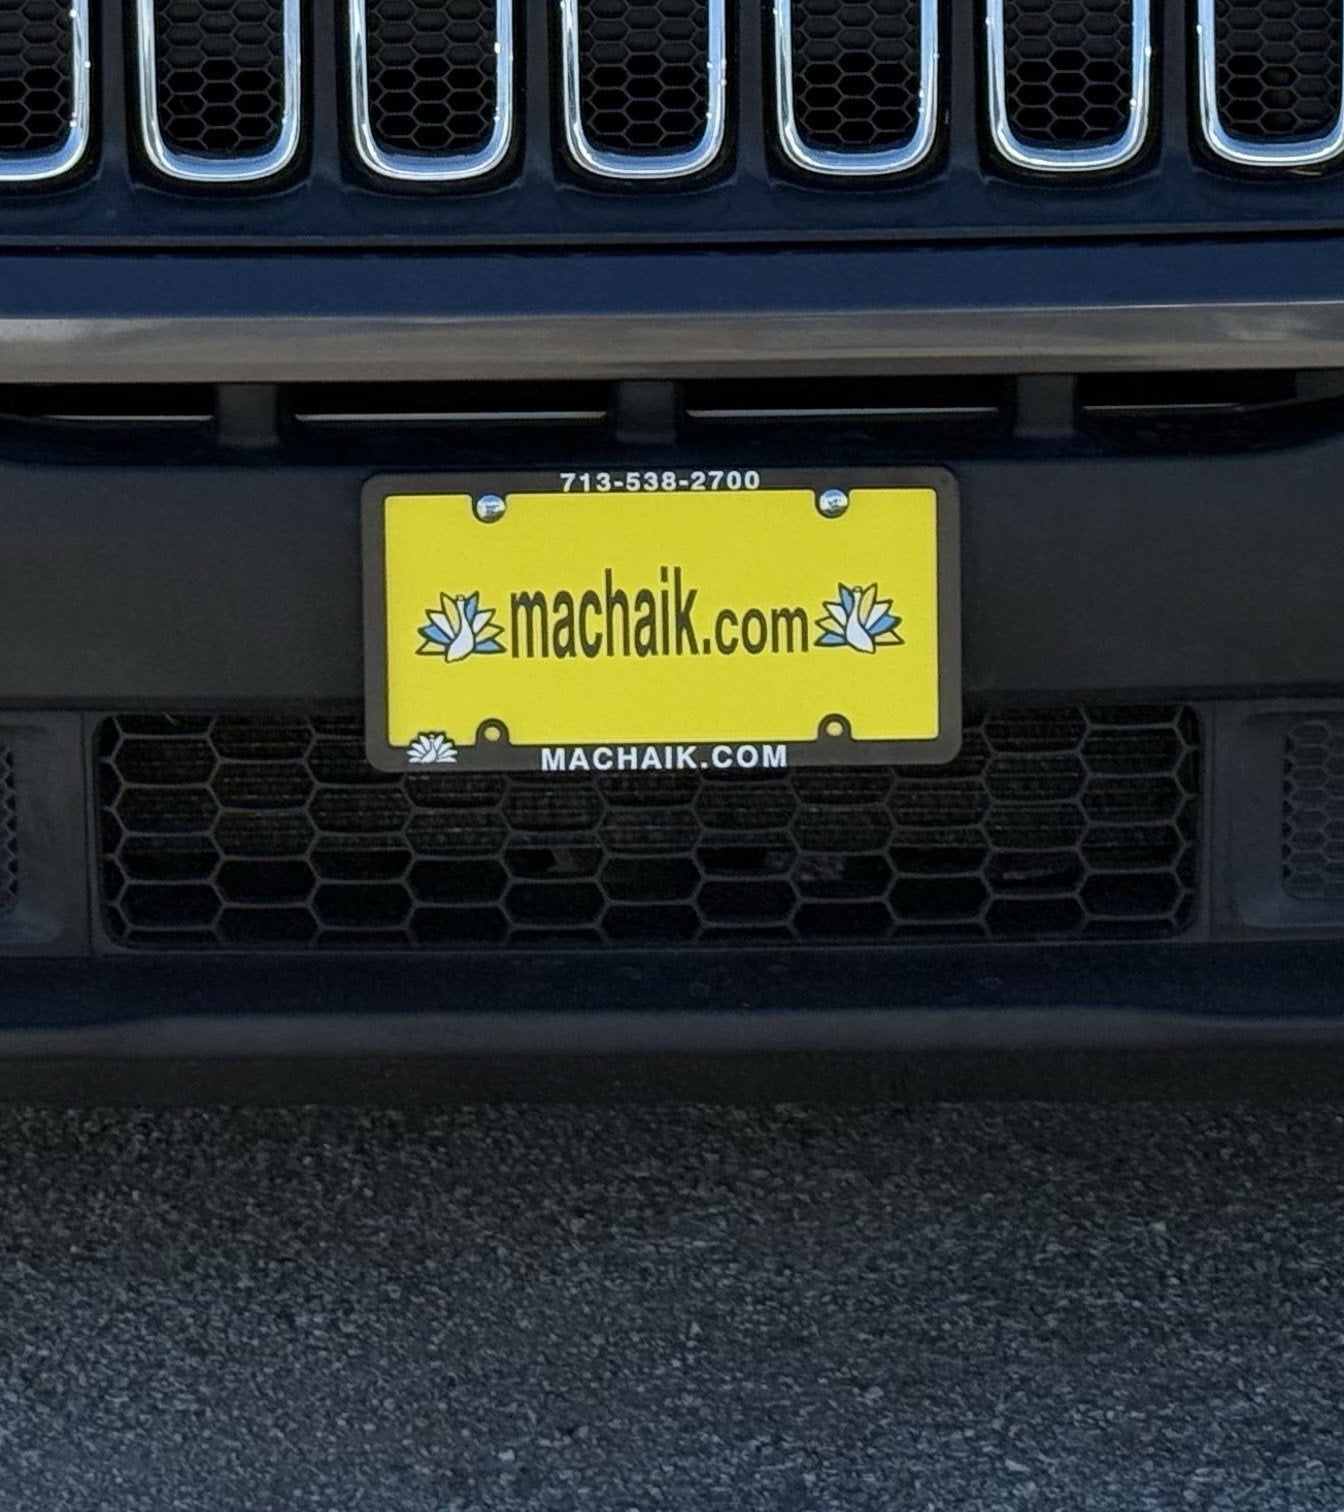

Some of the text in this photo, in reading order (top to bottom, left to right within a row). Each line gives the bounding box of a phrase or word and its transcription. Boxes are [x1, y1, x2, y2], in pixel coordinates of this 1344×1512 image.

[560, 470, 760, 493] 713-538-2700
[511, 565, 809, 659] machaik.com
[541, 745, 788, 771] MACHAIK.COM
